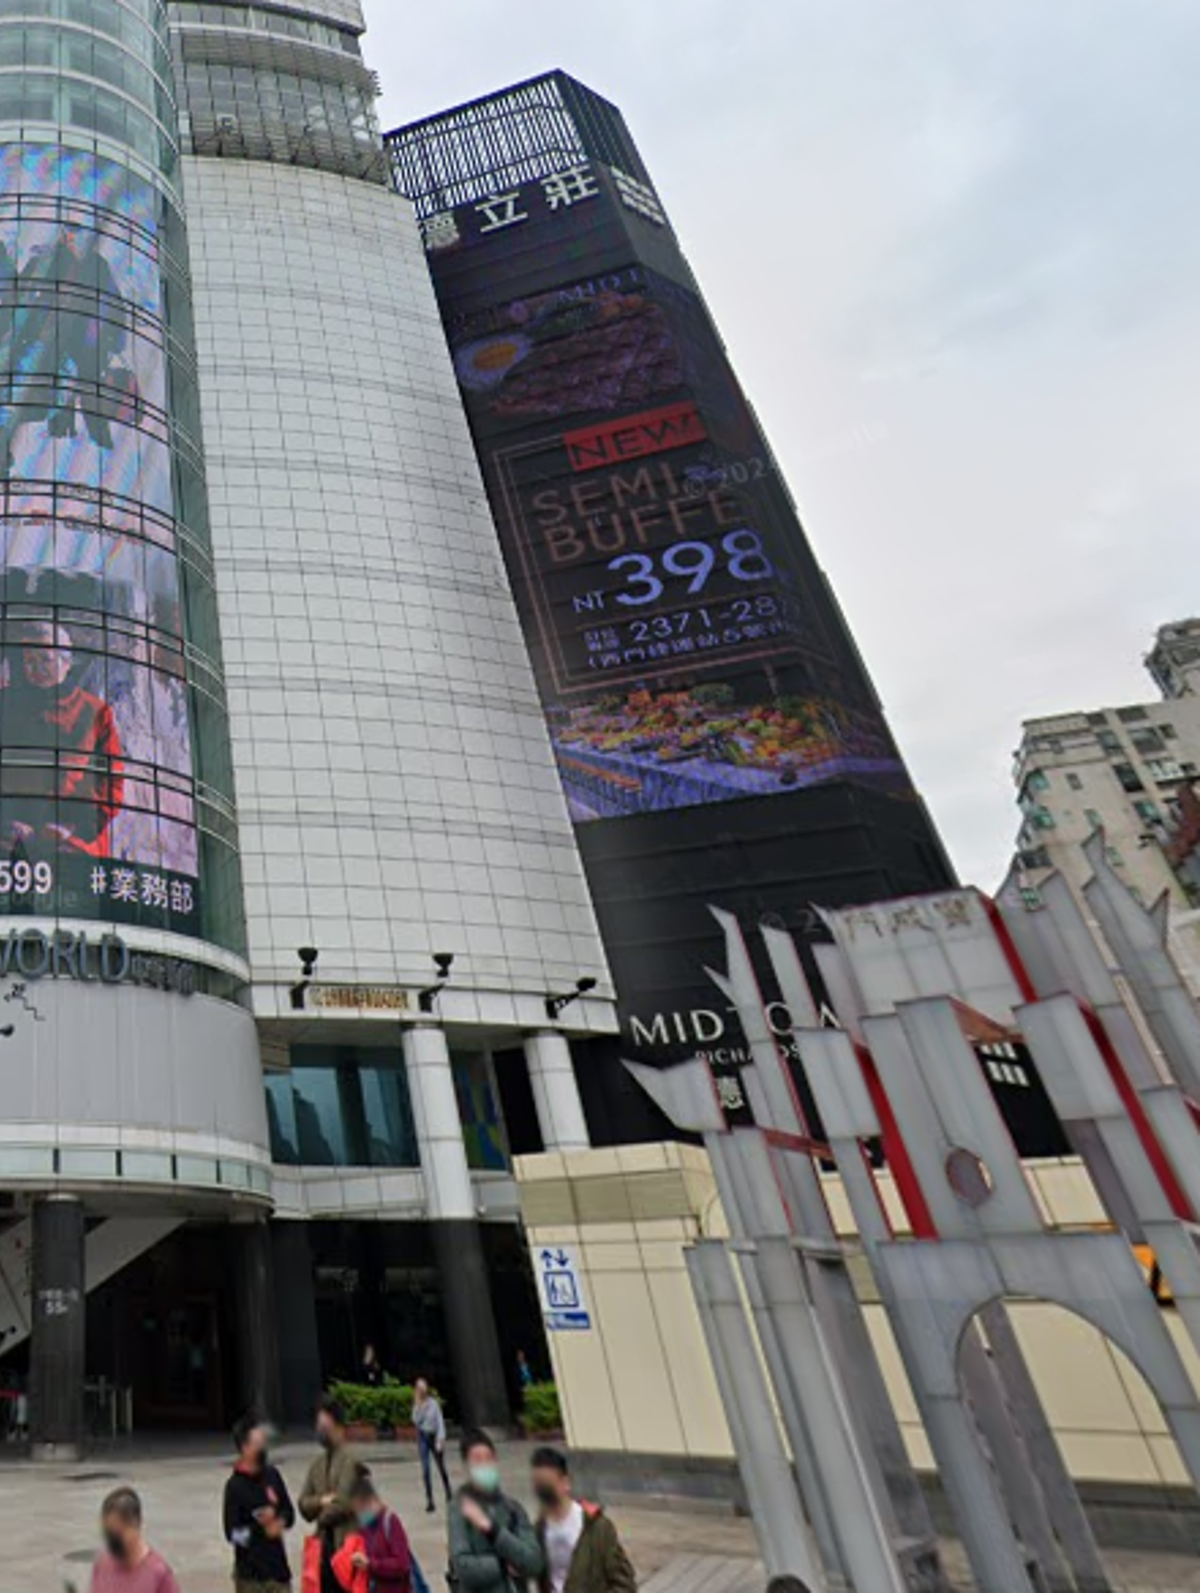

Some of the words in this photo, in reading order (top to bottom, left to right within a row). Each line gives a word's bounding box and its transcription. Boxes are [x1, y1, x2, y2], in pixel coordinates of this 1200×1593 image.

[571, 413, 692, 467] NEW
[544, 489, 750, 562] BUFFE
[607, 529, 777, 606] 398
[90, 864, 194, 914] #業務部
